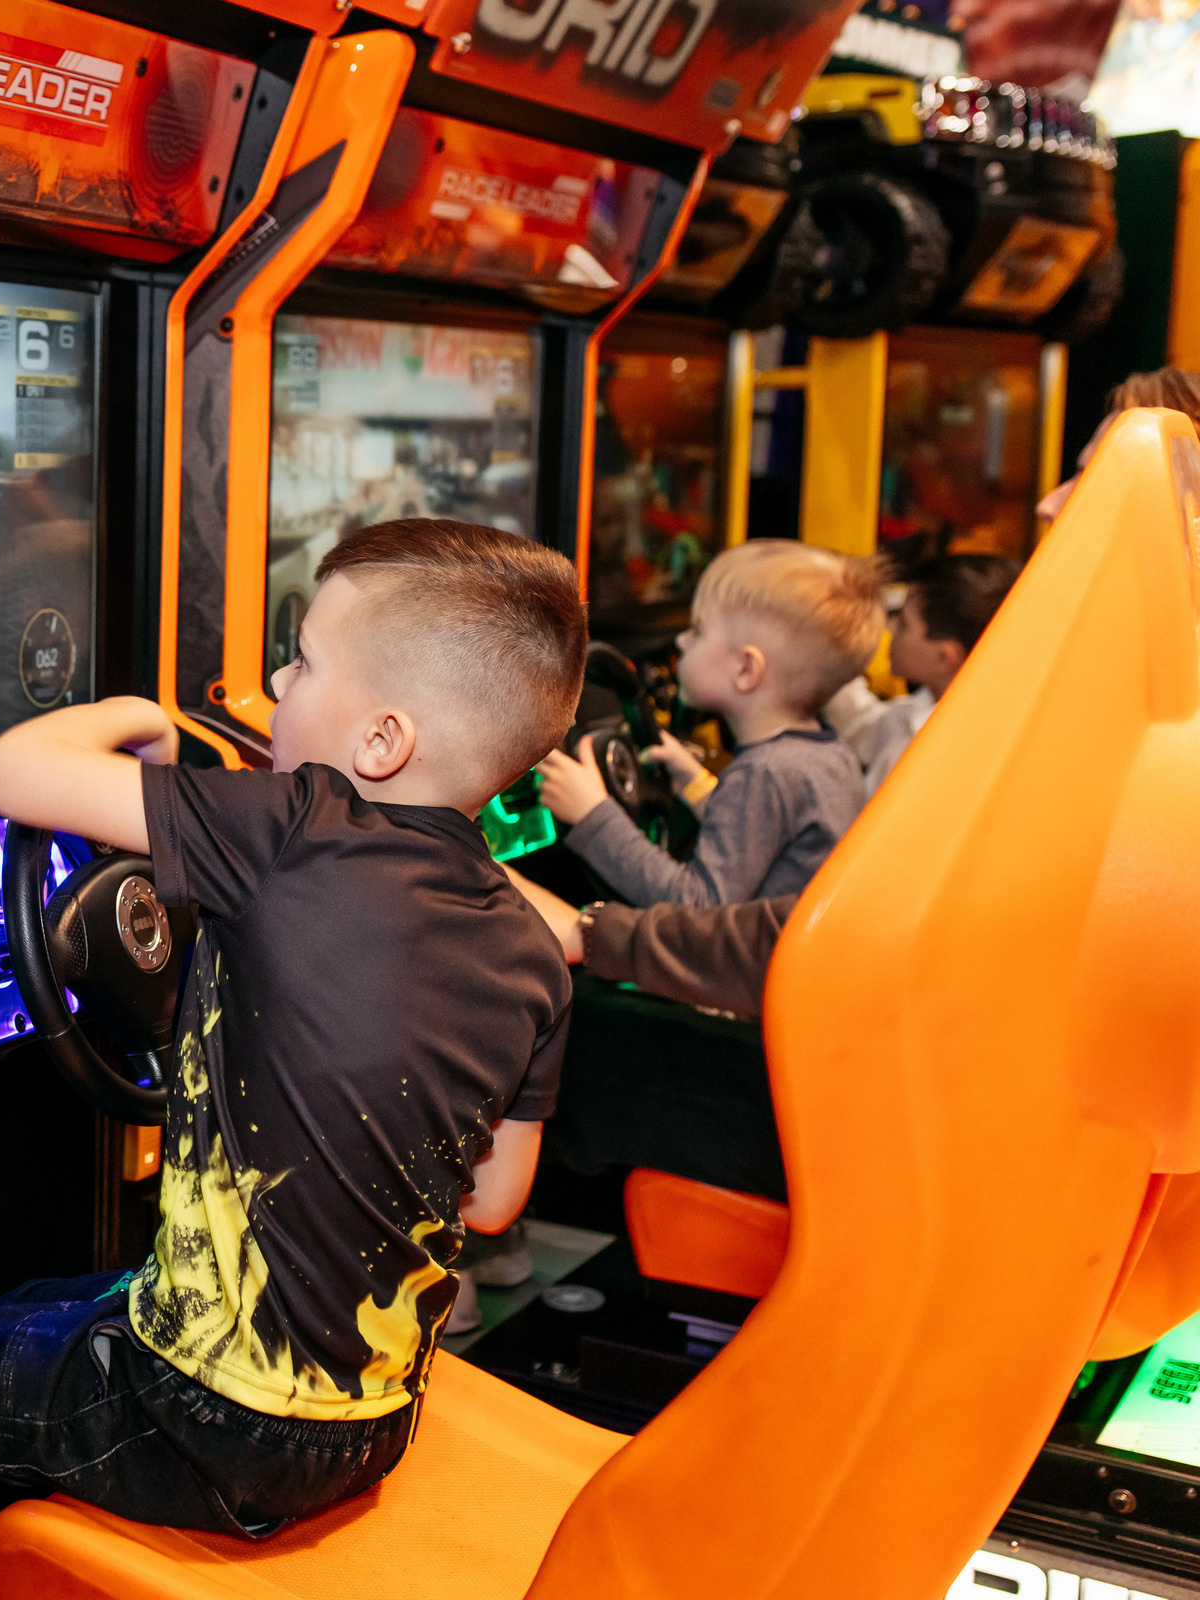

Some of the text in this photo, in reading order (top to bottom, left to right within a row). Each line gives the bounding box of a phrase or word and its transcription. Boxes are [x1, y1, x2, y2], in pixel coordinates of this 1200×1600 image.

[19, 320, 76, 370] 6 6
[132, 916, 154, 933] SEGA
